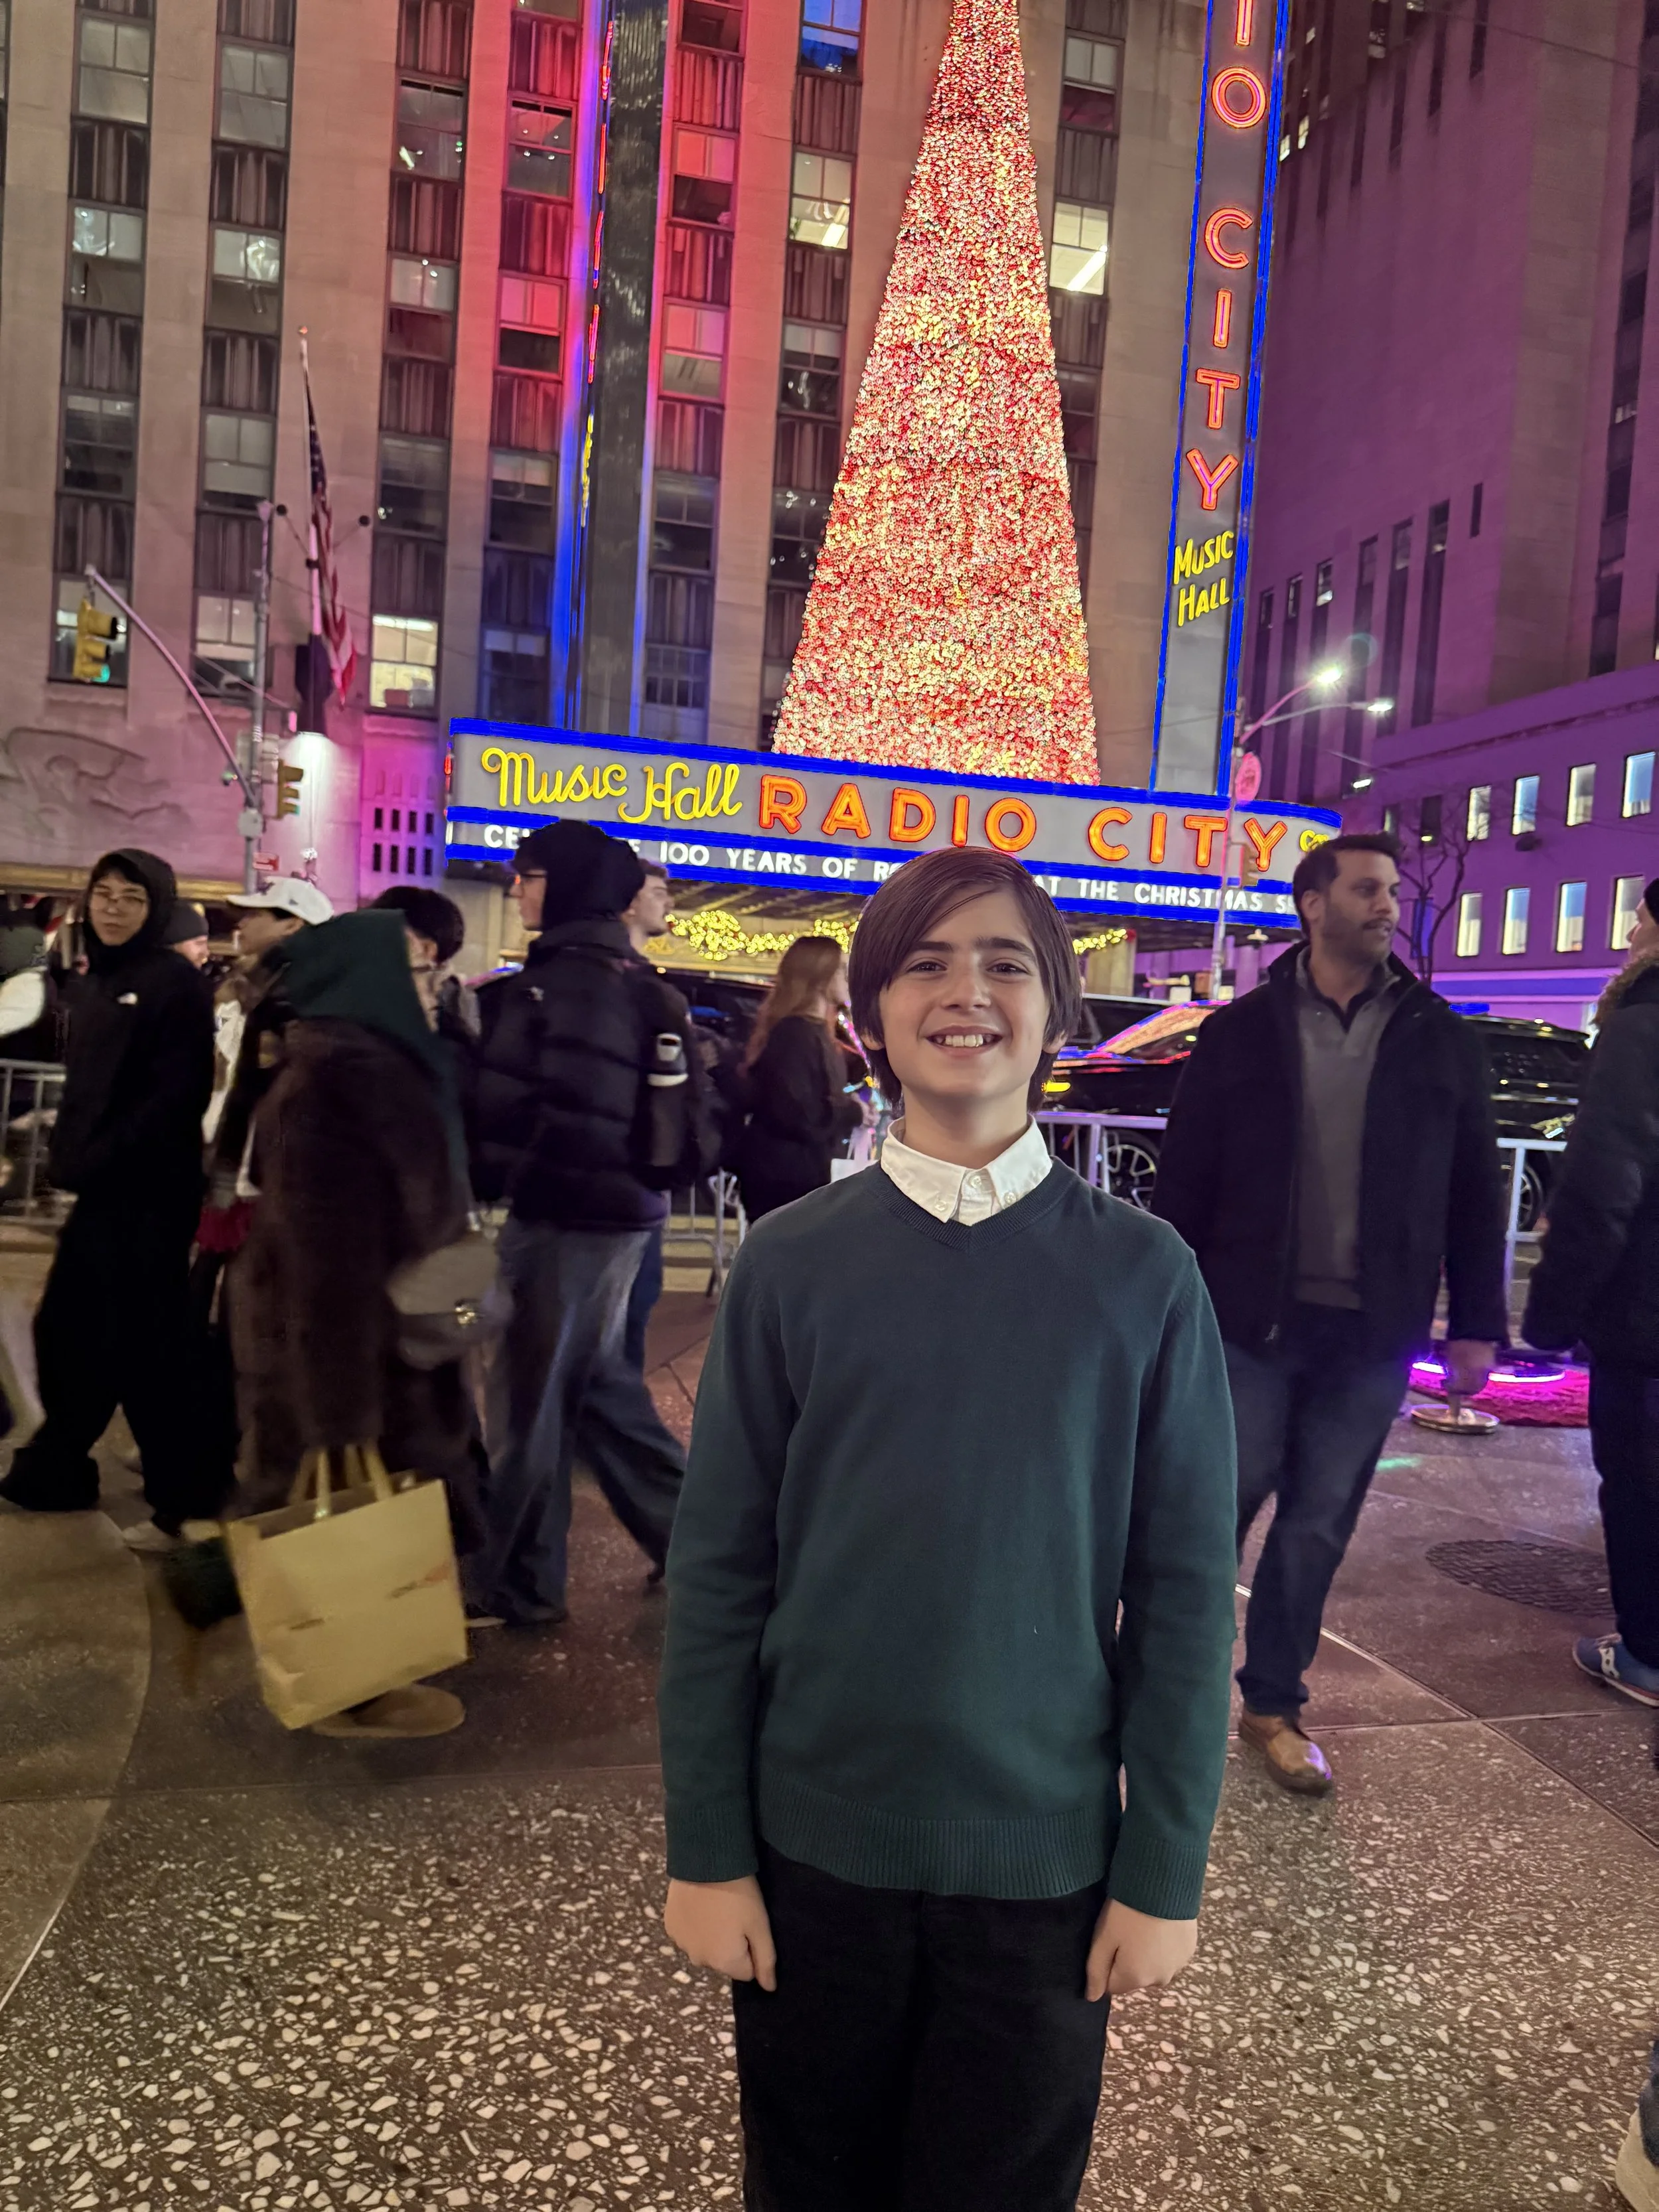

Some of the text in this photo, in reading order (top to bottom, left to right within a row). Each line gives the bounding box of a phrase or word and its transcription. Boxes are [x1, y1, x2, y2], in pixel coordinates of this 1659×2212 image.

[1185, 207, 1253, 511] CITY
[481, 747, 1289, 872] Music Hall RADIO CITY
[660, 840, 709, 867] 100
[727, 848, 808, 874] YEARS
[822, 857, 857, 879] OF
[1078, 878, 1119, 901] THE
[1134, 883, 1263, 911] CHRISTMAS
